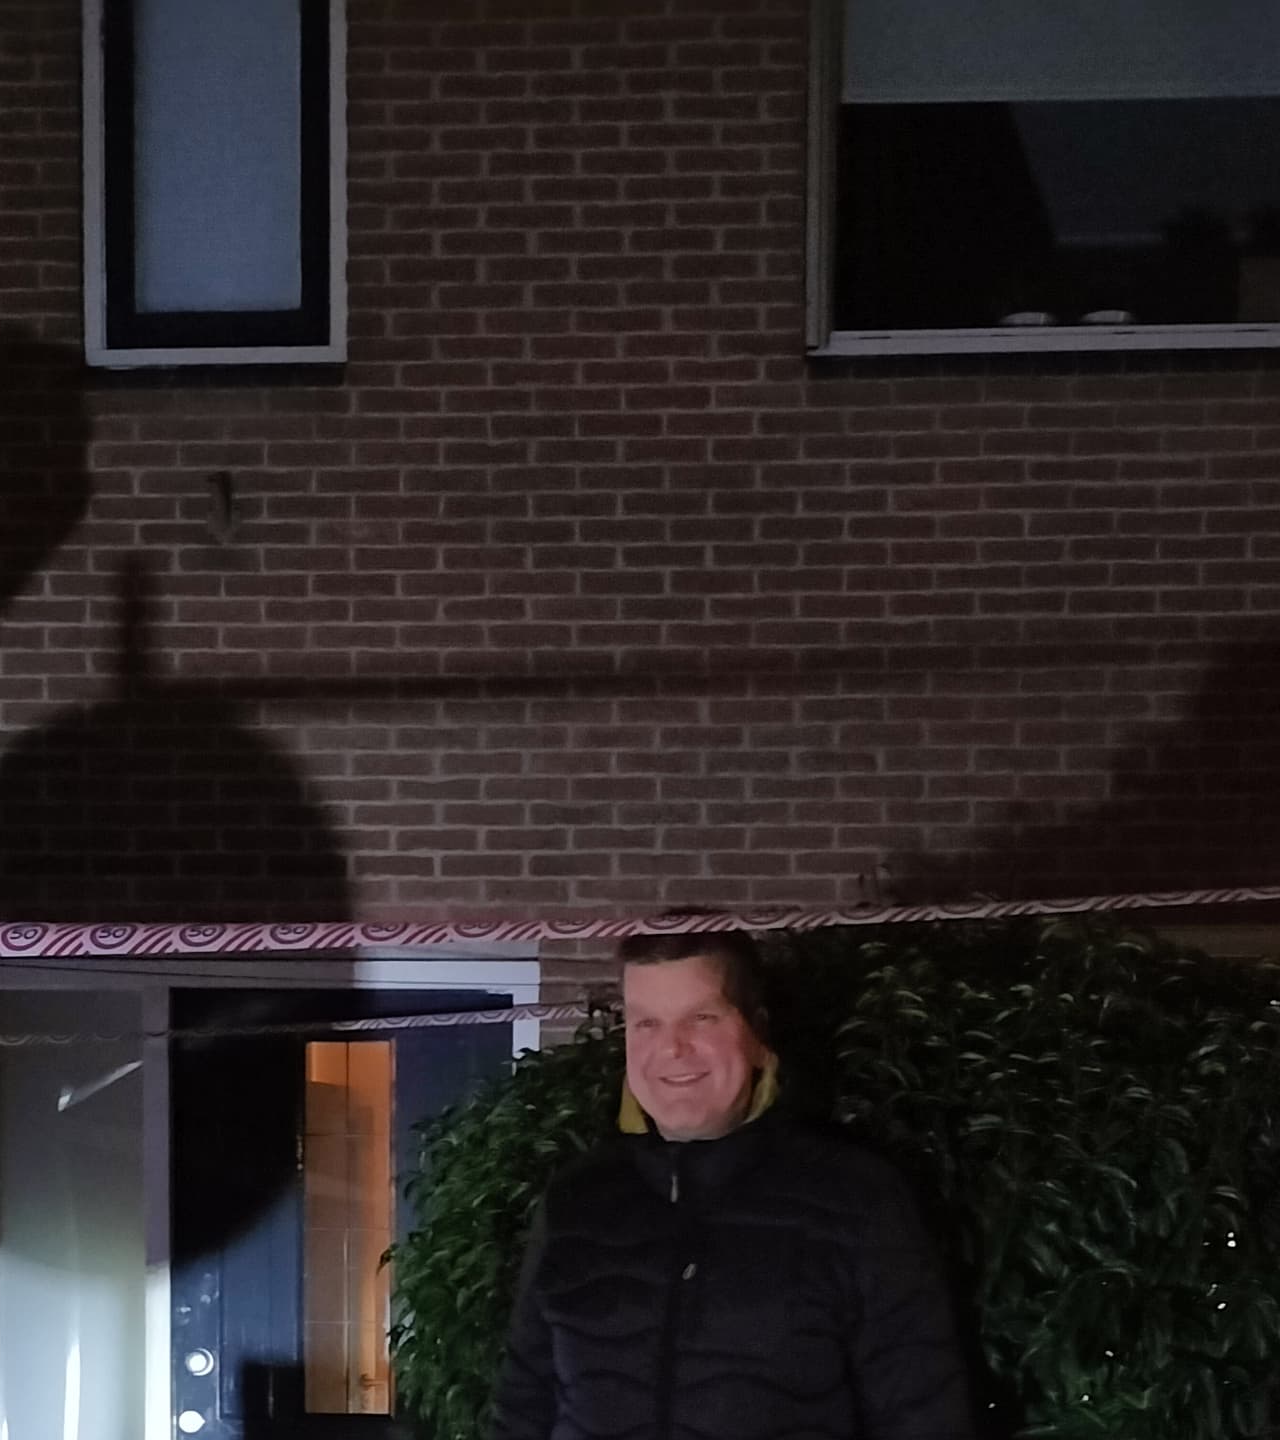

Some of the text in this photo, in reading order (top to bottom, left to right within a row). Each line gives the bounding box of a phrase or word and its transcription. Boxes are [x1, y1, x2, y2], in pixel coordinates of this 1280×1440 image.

[10, 928, 37, 940] 50
[99, 927, 126, 939] 50
[187, 926, 216, 937] 50
[279, 925, 307, 935] 50
